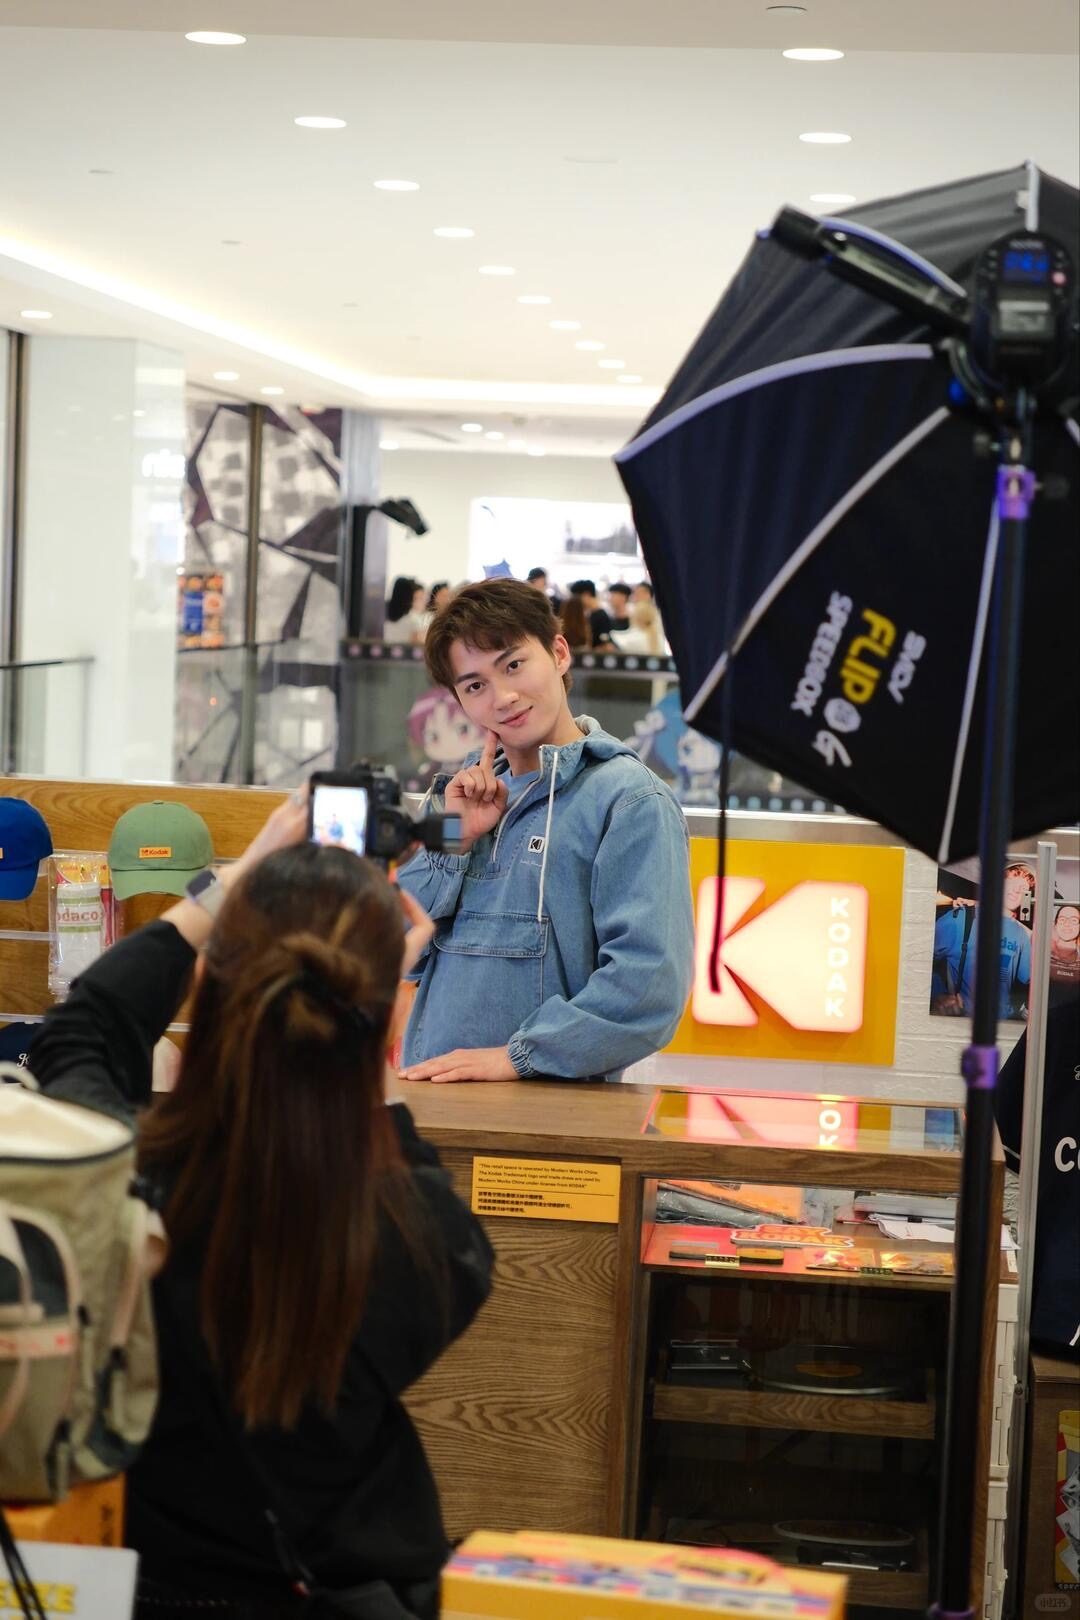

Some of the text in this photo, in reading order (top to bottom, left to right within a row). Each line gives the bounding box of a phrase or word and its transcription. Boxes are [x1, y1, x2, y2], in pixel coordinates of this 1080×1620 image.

[840, 608, 896, 704] FLIP
[824, 897, 851, 1018] KODAK
[738, 1231, 849, 1246] KODAK
